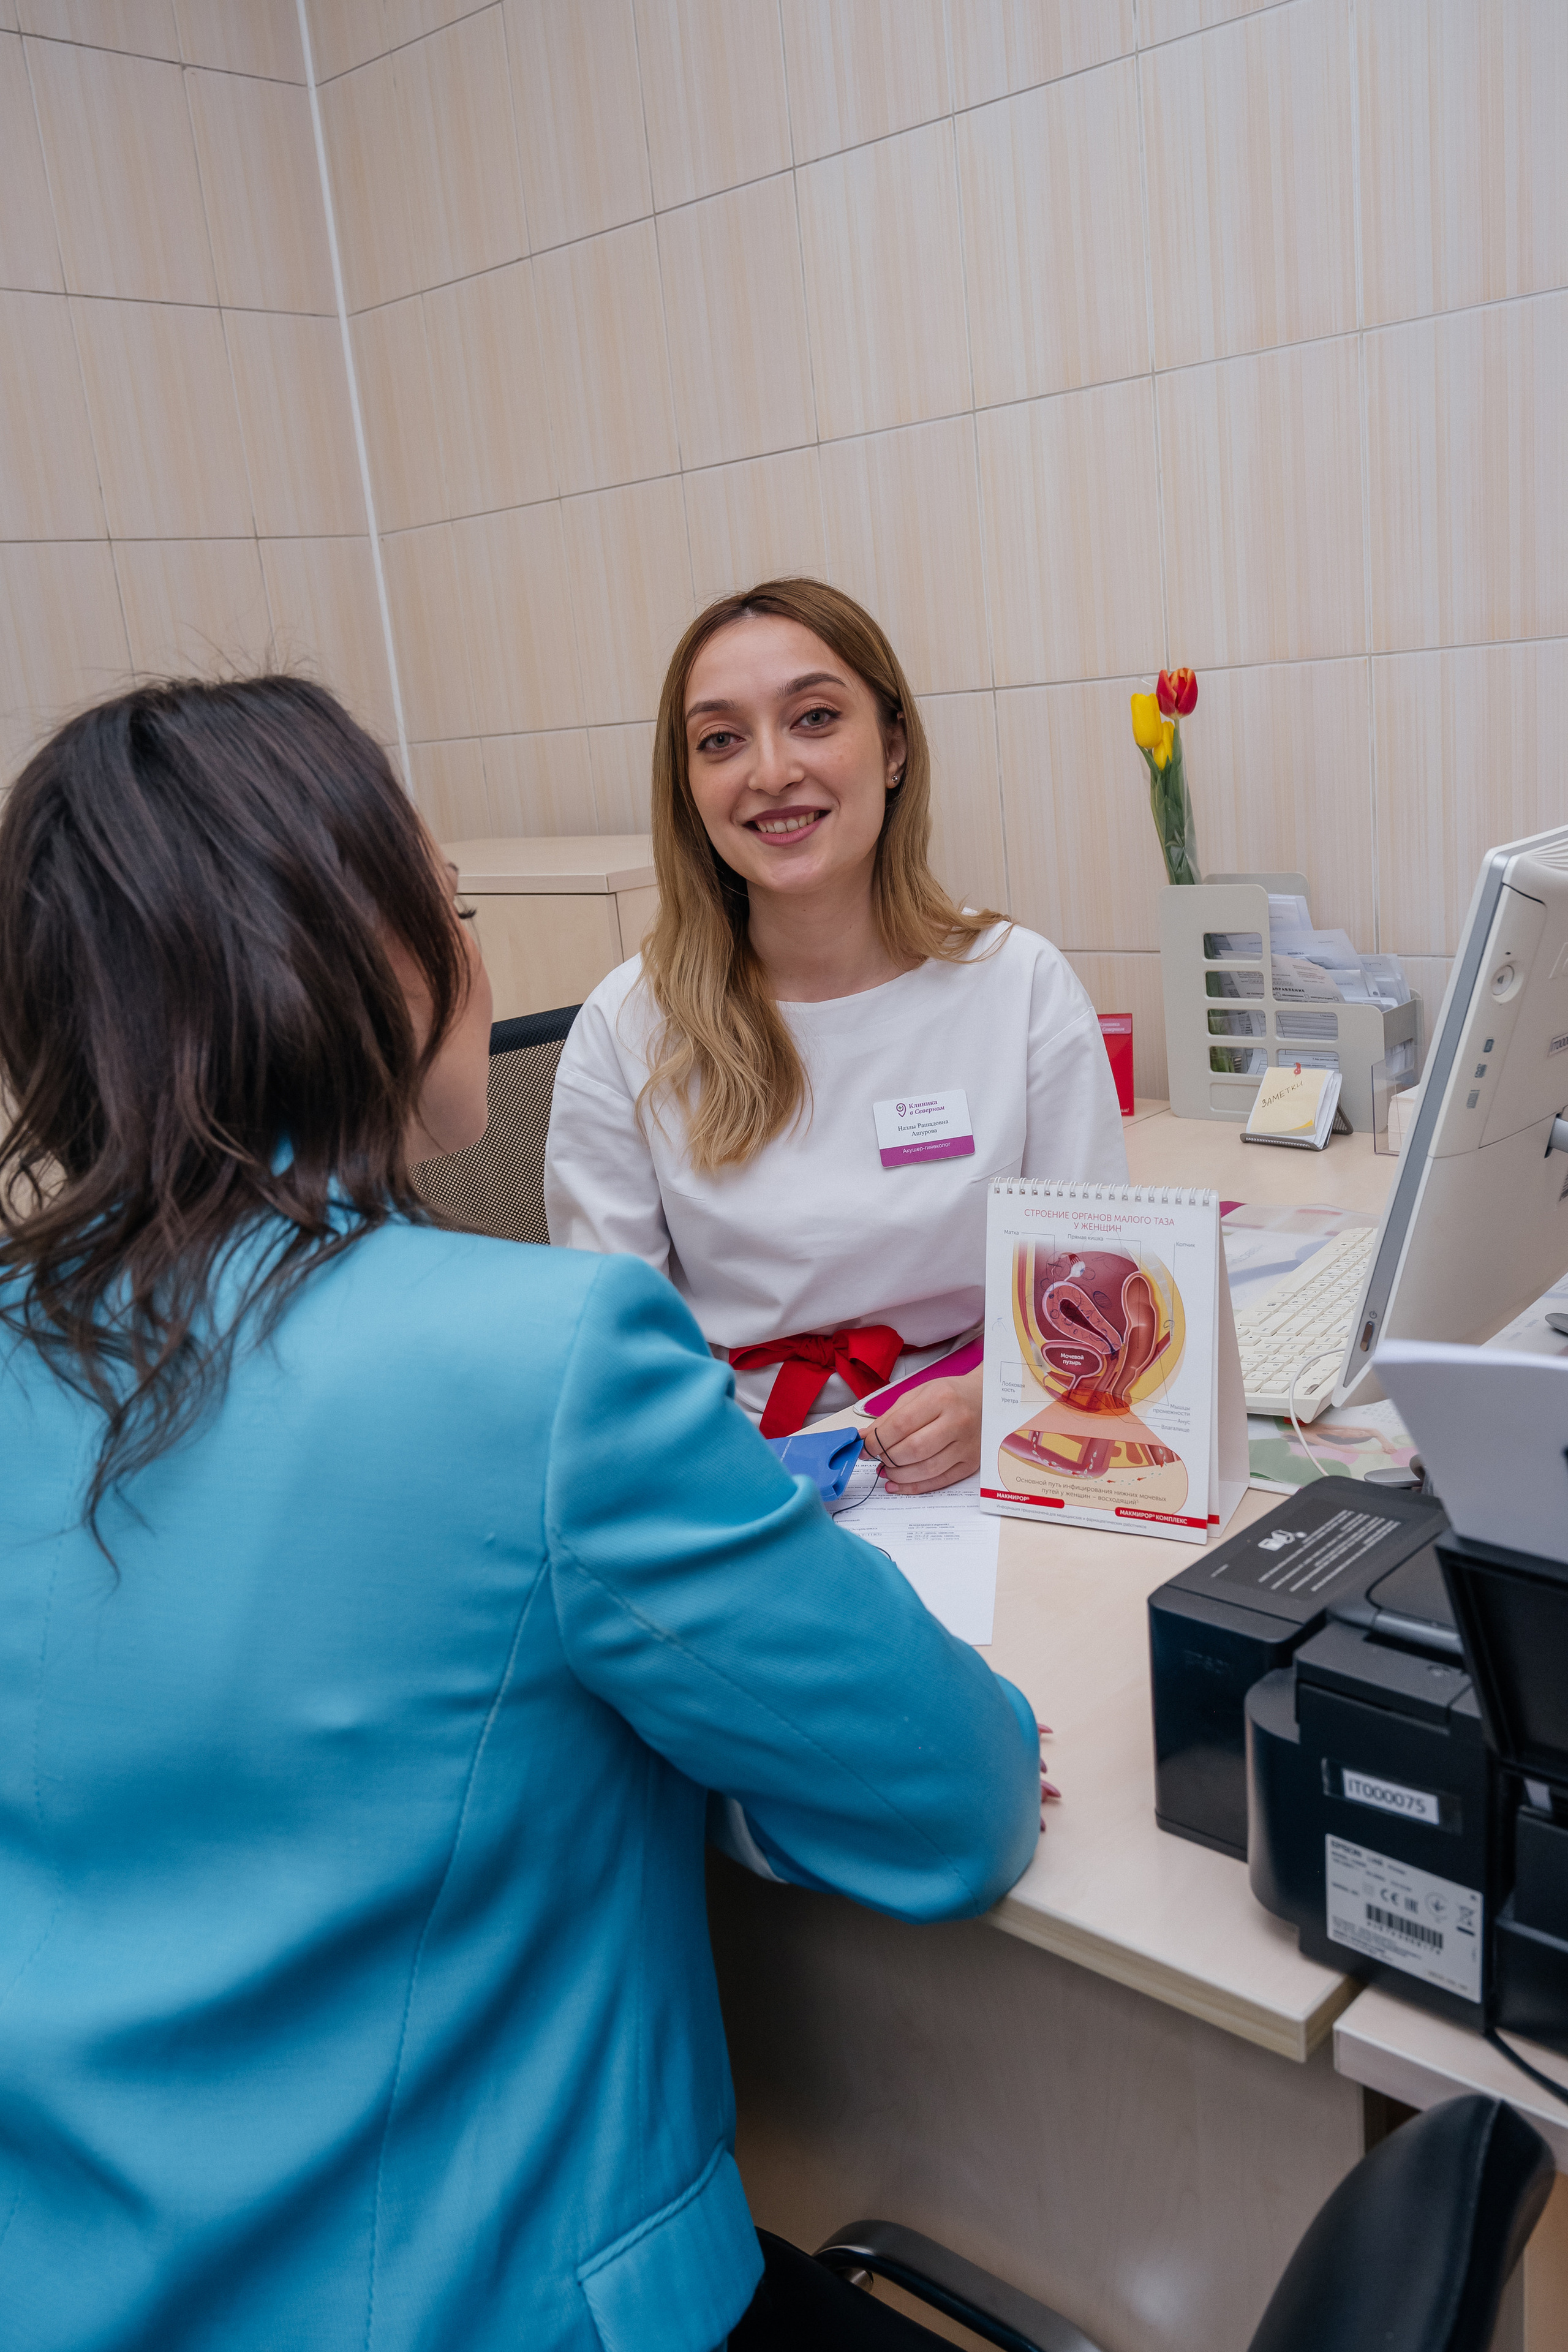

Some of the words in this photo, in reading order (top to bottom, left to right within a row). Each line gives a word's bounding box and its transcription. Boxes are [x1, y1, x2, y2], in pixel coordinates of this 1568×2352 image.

[1261, 1080, 1303, 1108] ЗАМЕТКИ
[908, 1100, 938, 1109] Клиника
[914, 1105, 945, 1115] Северном
[898, 1123, 916, 1132] Назлы
[918, 1119, 949, 1129] Рашадовна
[911, 1128, 937, 1137] Ашурова
[903, 1142, 951, 1154] Акушер-гинеколог
[1024, 1208, 1069, 1219] СТРОЕНИЕ
[1072, 1212, 1112, 1222] ОРГАНОВ
[1114, 1215, 1152, 1224] МАЛОГО
[1155, 1217, 1175, 1226] ТАЗА
[1081, 1223, 1121, 1232] ЖЕНЩИН
[1161, 1424, 1190, 1433] Влагалище
[1016, 1476, 1047, 1485] Основной
[1063, 1483, 1113, 1494] инфицирования
[1139, 1493, 1167, 1502] мочевых
[997, 1504, 1020, 1512] Информация
[1155, 1515, 1188, 1525] КОМПЛЕКС
[1348, 1779, 1426, 1814] IT000075
